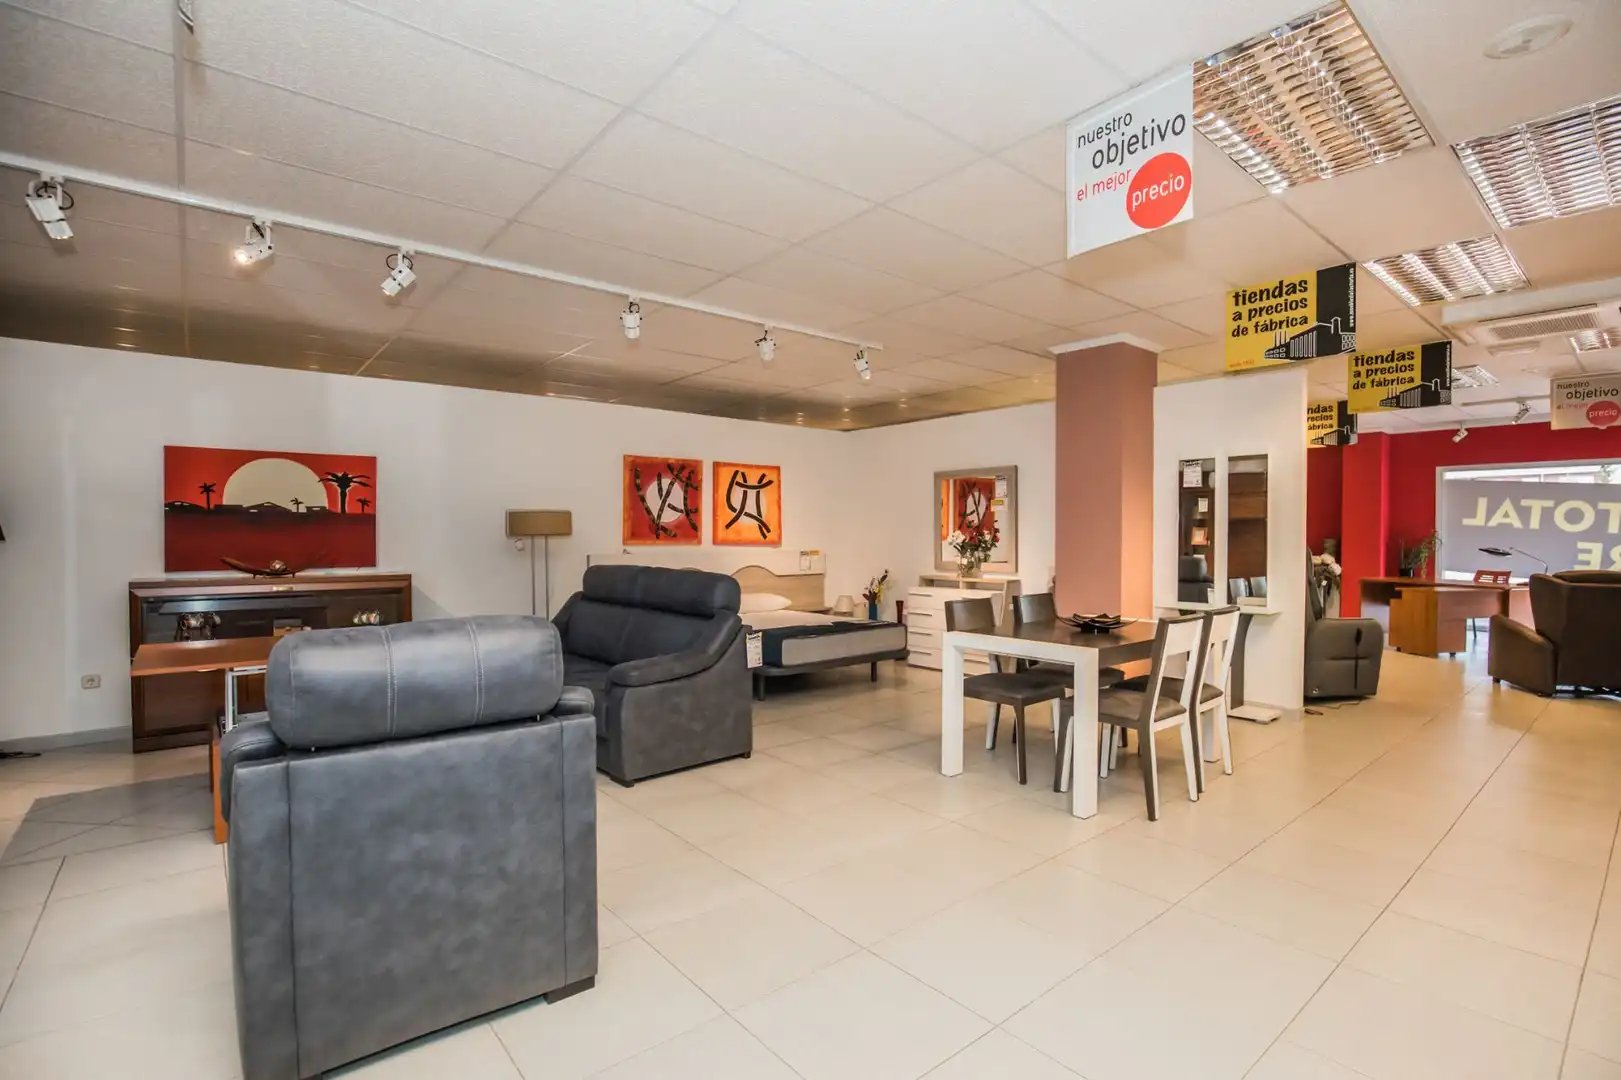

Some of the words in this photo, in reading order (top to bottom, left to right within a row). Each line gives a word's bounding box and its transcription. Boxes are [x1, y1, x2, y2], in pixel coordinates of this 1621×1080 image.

[1077, 112, 1133, 149] nuestro
[1092, 113, 1186, 170] objetivo
[1077, 184, 1088, 202] el
[1092, 169, 1131, 195] mejor
[1132, 173, 1185, 211] precio
[1232, 280, 1308, 307] tiendas
[1232, 311, 1243, 322] a
[1248, 297, 1308, 322] precios
[1231, 325, 1249, 338] de
[1253, 315, 1308, 334] fábrica
[1353, 350, 1415, 368] tiendas
[1353, 370, 1362, 379] a
[1365, 363, 1415, 379] precios
[1352, 380, 1366, 390] de
[1370, 376, 1415, 388] fábrica
[1557, 381, 1590, 390] nuestro
[1566, 386, 1619, 401] objetivo
[1307, 404, 1334, 415] ndas
[1589, 408, 1618, 418] precio
[1307, 414, 1334, 423] recios
[1307, 423, 1334, 431] ábrica
